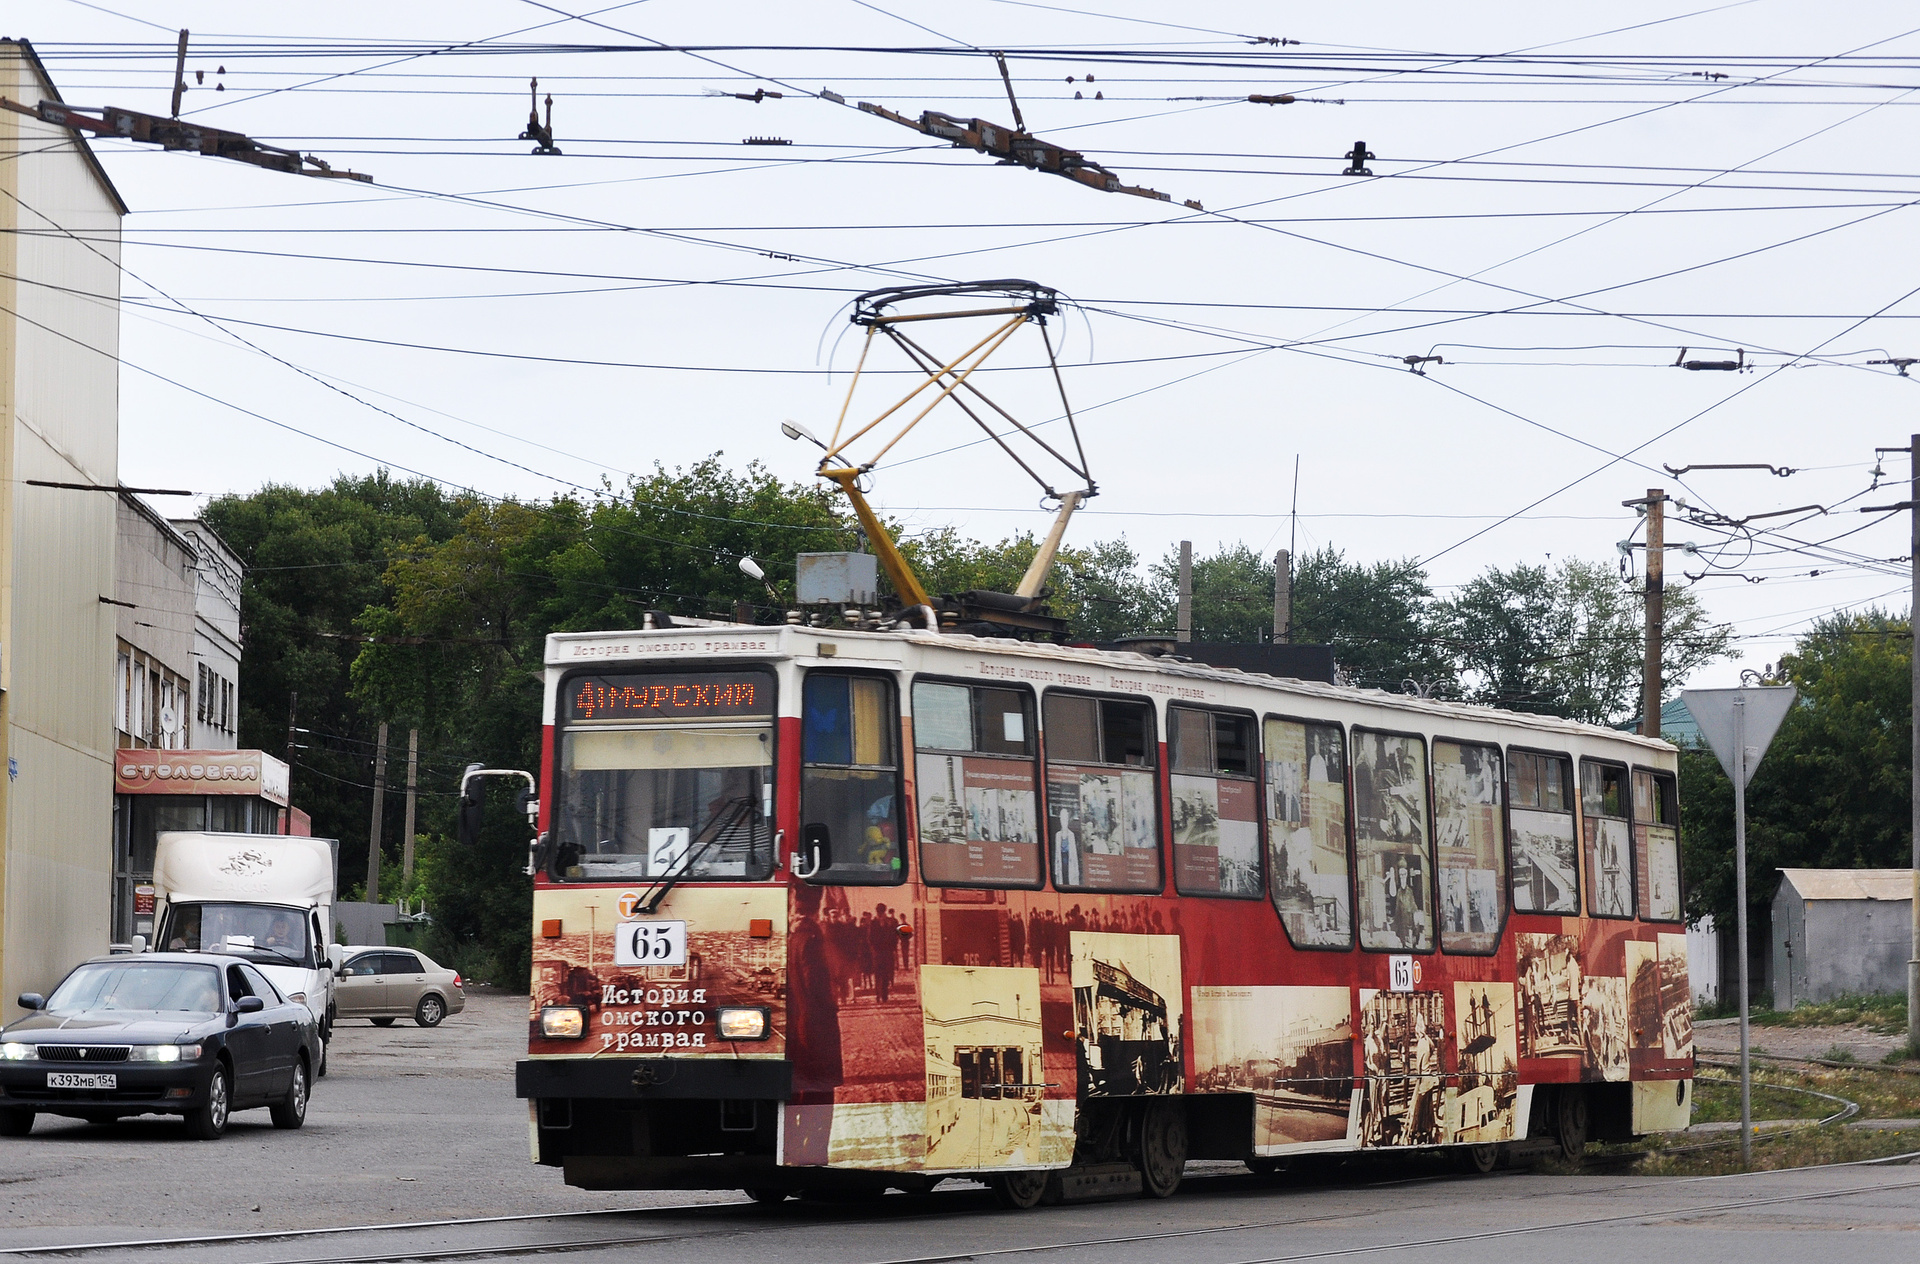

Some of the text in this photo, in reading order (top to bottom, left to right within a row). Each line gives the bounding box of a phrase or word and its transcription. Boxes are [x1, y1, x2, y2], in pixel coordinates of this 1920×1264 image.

[573, 641, 767, 657] История омского трамвая
[120, 763, 259, 782] СТОЛОВАЯ
[653, 833, 678, 870] 4
[632, 926, 672, 960] 65
[1395, 960, 1409, 987] 65
[601, 984, 707, 1007] История
[601, 1010, 705, 1026] омского
[600, 1032, 706, 1051] трамвая
[96, 1074, 115, 1085] 154
